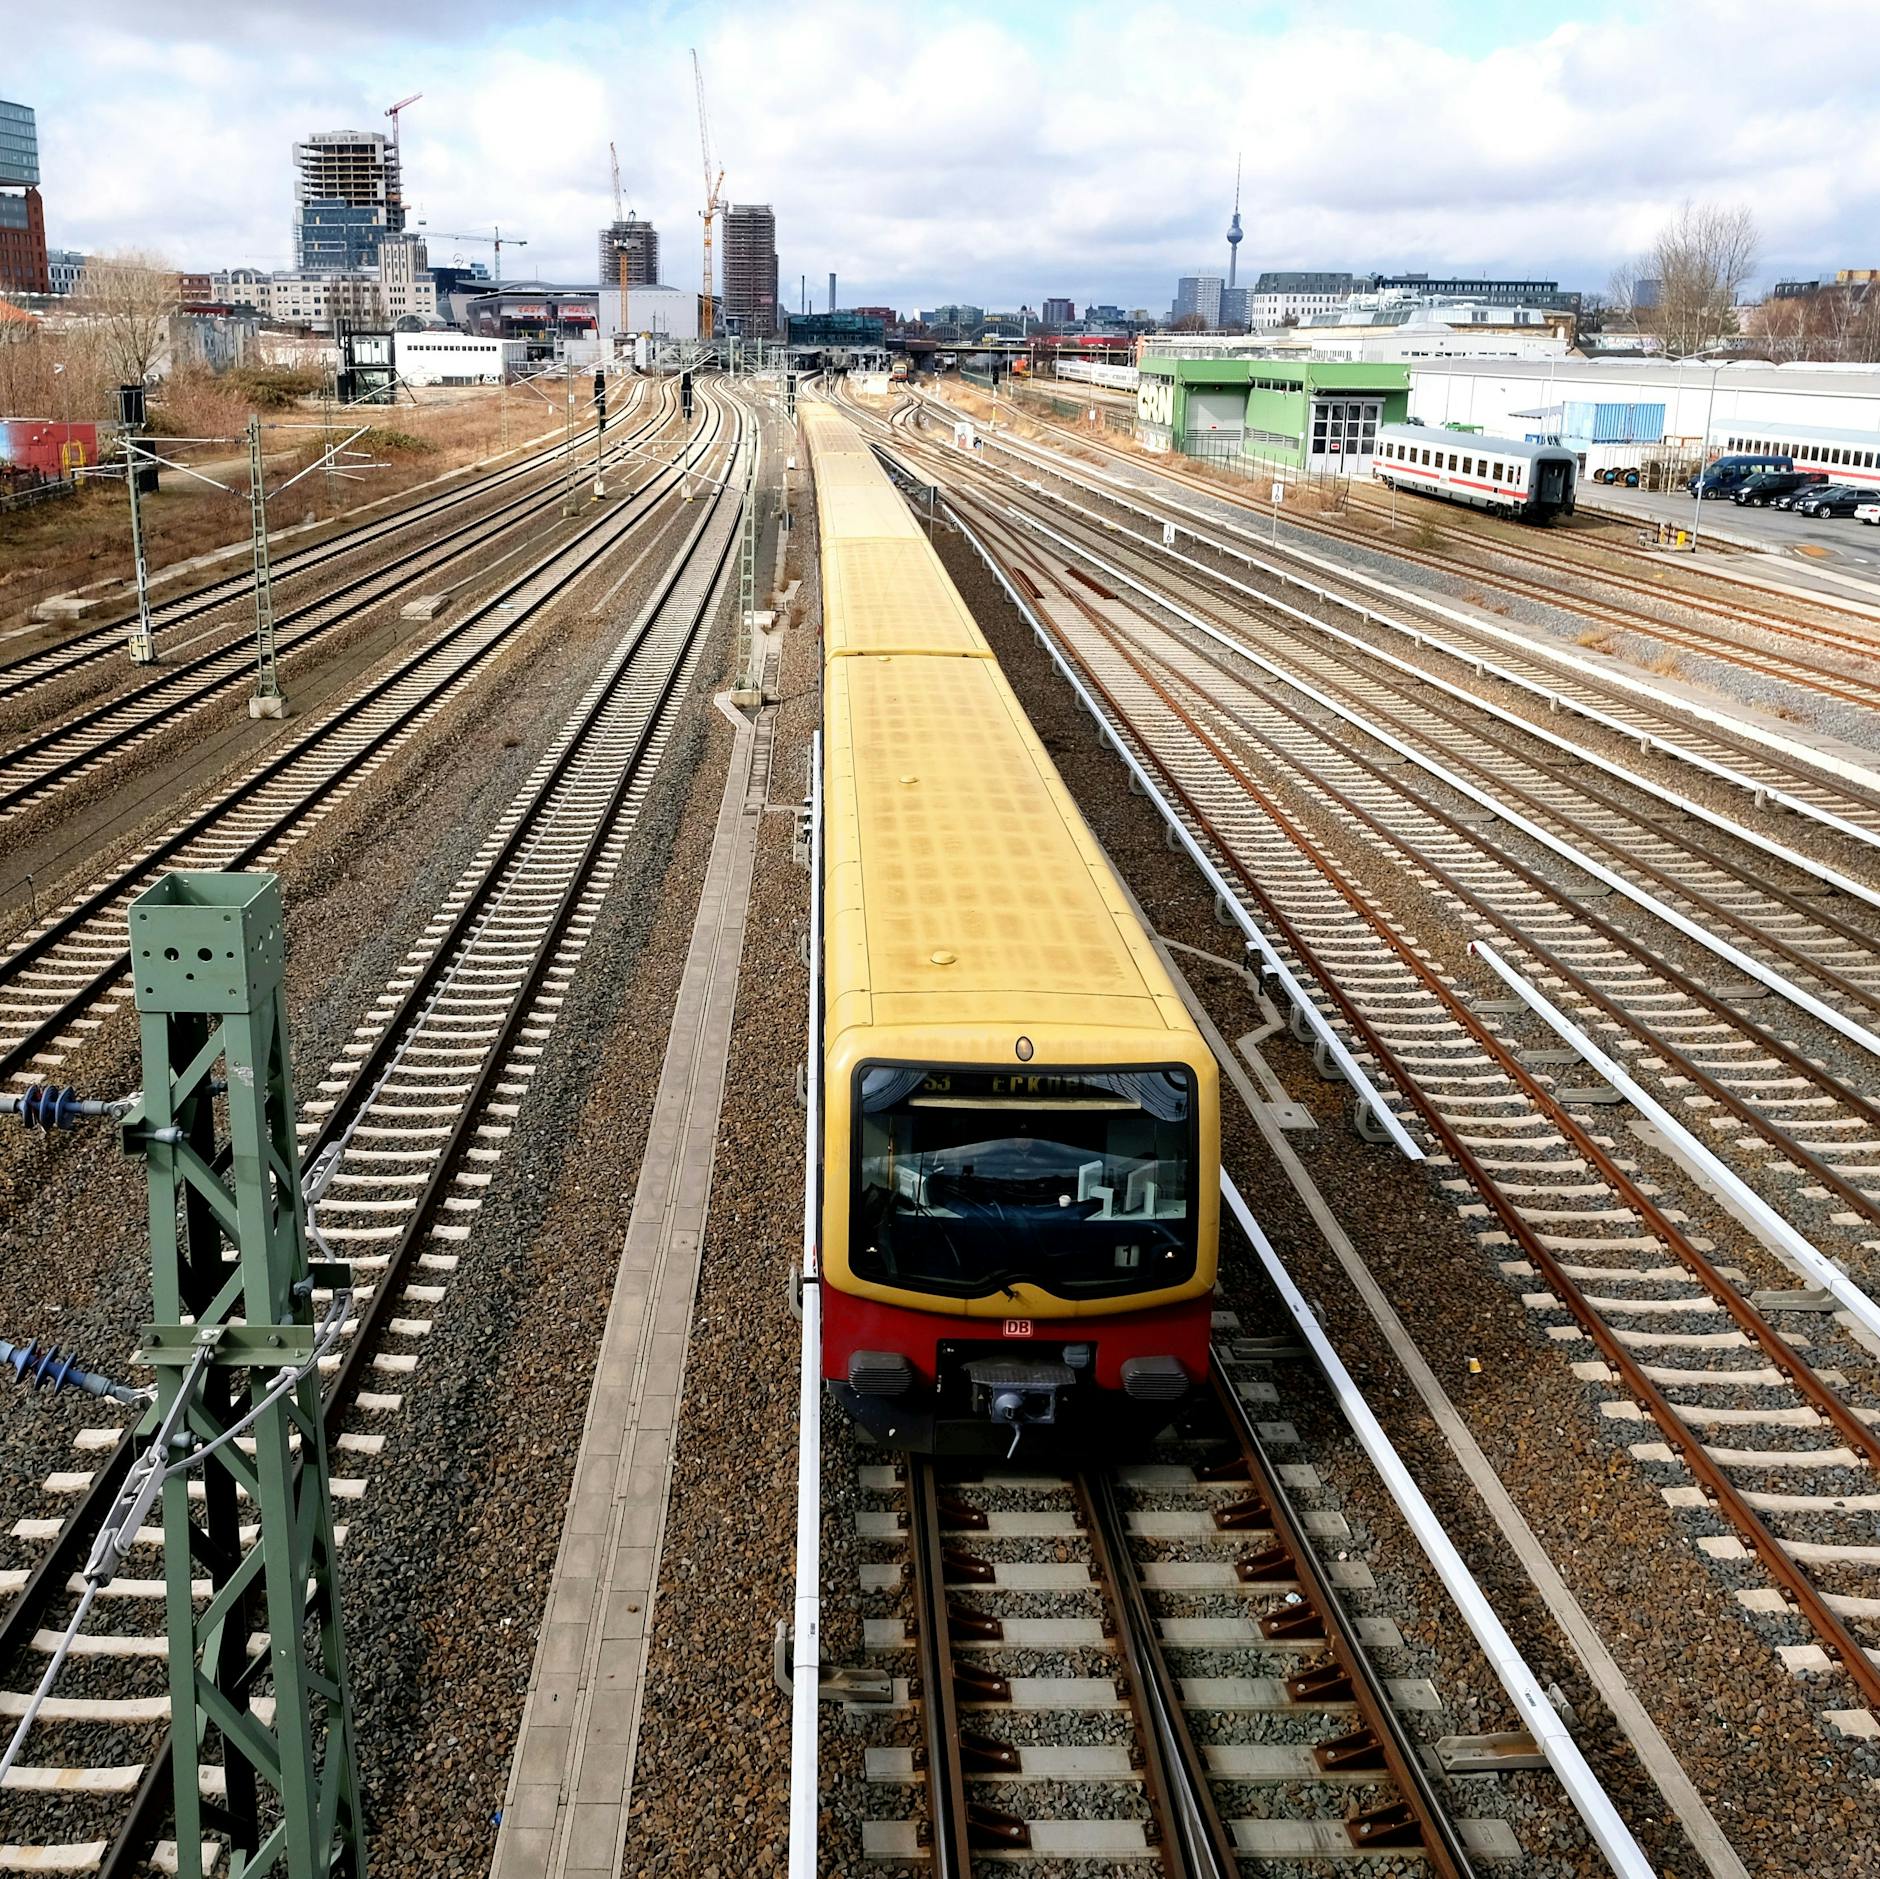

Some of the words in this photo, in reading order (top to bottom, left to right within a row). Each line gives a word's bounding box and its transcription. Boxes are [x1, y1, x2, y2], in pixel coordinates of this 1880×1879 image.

[922, 1073, 951, 1091] S3
[1122, 1245, 1132, 1265] 1
[1007, 1321, 1029, 1333] DB
